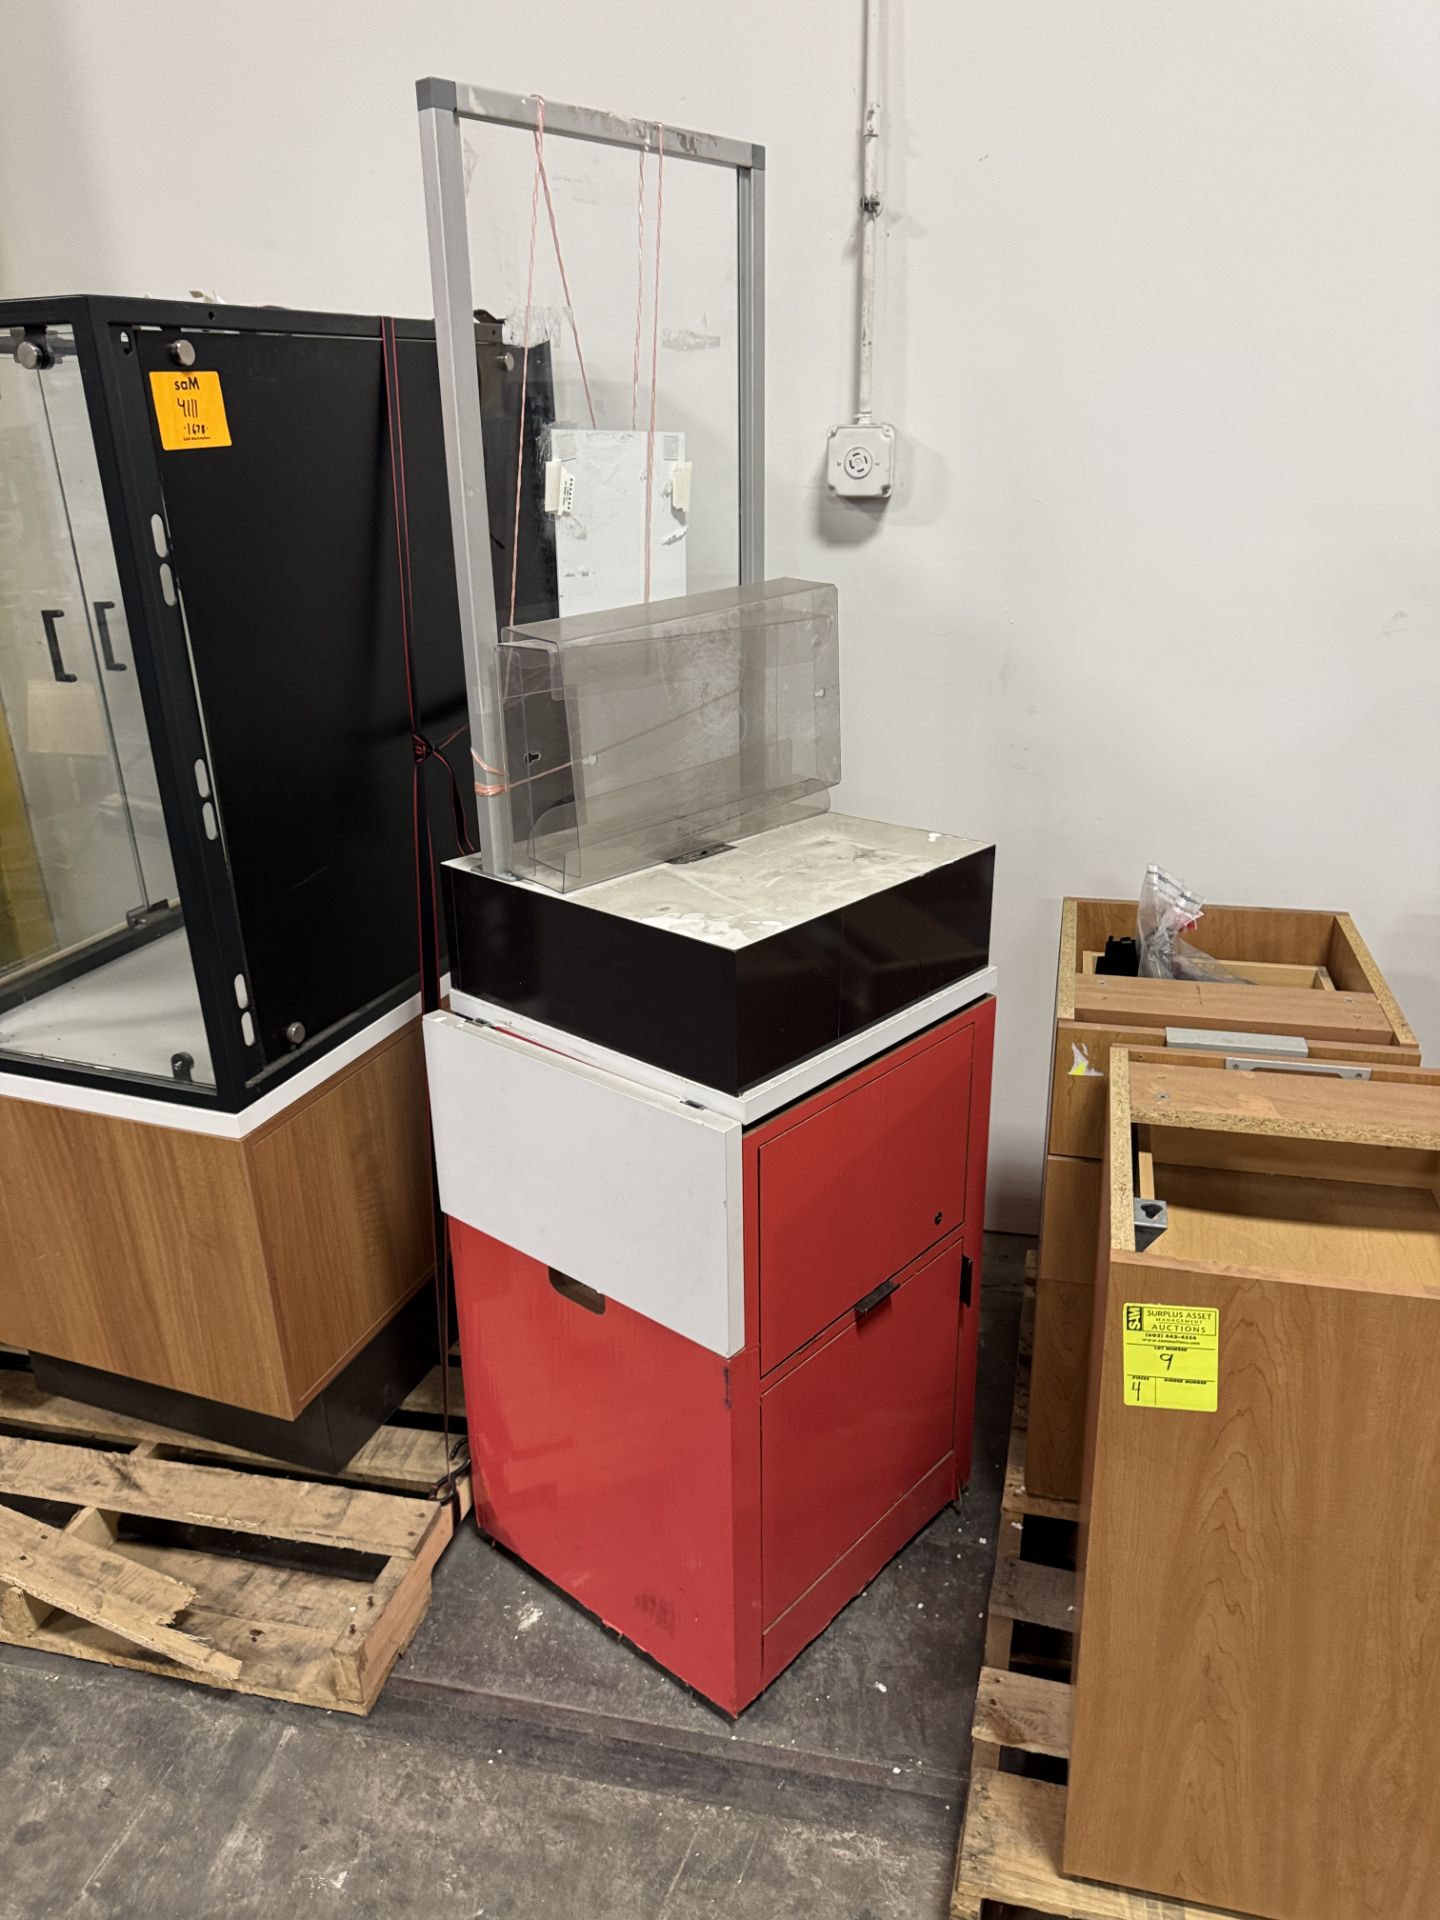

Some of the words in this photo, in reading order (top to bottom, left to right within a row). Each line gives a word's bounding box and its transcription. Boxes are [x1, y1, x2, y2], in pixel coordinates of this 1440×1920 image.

[1147, 1309, 1184, 1318] SURPLUS
[1186, 1312, 1212, 1320] ASSET
[1151, 1324, 1206, 1333] AUCTIONS
[1159, 1353, 1174, 1371] 9
[1131, 1381, 1141, 1401] 4
